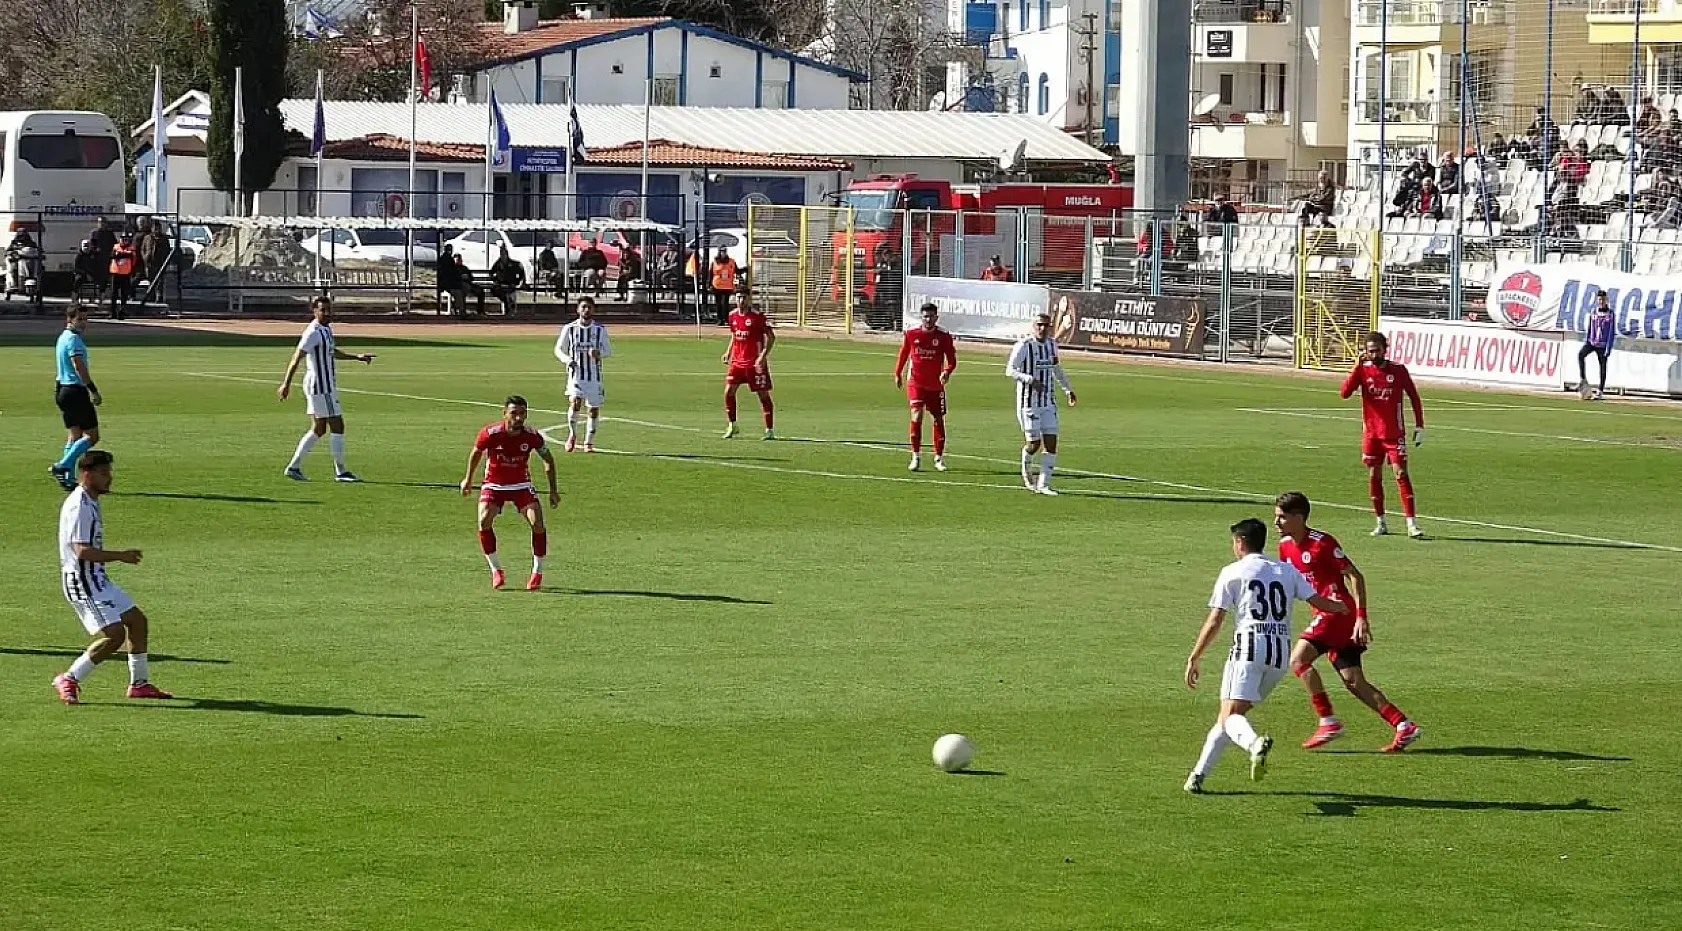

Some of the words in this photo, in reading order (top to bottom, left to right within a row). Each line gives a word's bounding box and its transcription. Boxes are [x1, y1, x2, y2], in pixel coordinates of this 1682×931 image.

[1065, 194, 1102, 206] MUĞLA
[1115, 296, 1157, 316] FETHİYE
[1556, 279, 1682, 340] APCH
[1079, 317, 1136, 335] DONDURMA
[1137, 319, 1182, 338] DÜNYASI
[1385, 330, 1471, 369] ABDULLAH
[1473, 335, 1561, 377] KOYUNCU
[1248, 579, 1288, 621] 30
